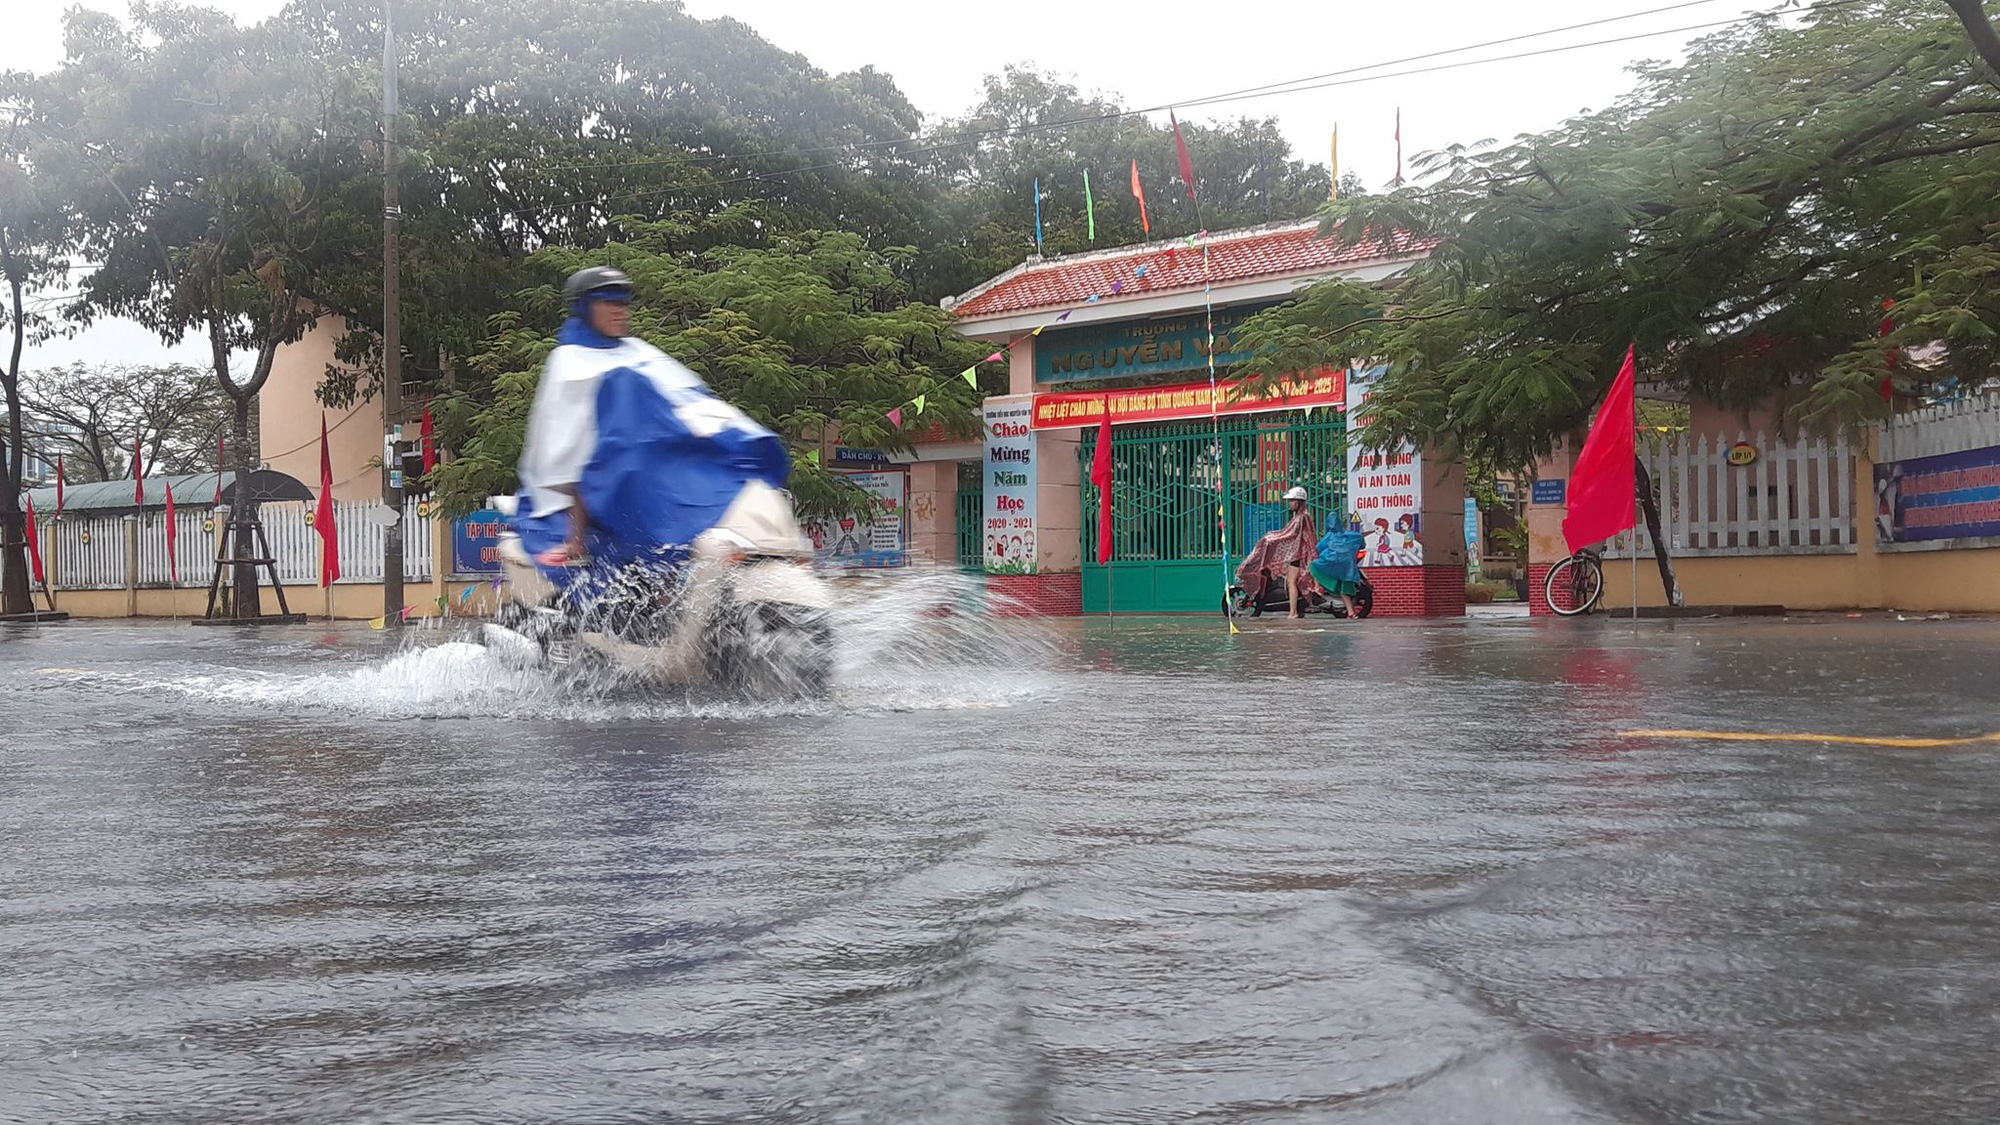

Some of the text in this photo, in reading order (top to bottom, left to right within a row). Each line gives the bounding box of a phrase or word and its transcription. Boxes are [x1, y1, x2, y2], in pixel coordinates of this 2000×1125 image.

[1051, 332, 1183, 374] NGUYỄN
[1038, 402, 1056, 421] NHIỆT
[1056, 400, 1069, 421] LIỆT
[1069, 399, 1086, 416] CHÀO
[1086, 397, 1105, 416] MỪNG
[1108, 398, 1118, 417] ẠI
[1117, 395, 1129, 416] HỘI
[1147, 391, 1157, 413] BỘ
[1195, 388, 1211, 406] NAM
[1314, 376, 1332, 394] 2025
[992, 421, 1028, 437] Chào
[991, 446, 1031, 464] Mừng
[994, 471, 1028, 486] Năm
[1358, 471, 1411, 488] VÌ AN TOÀN
[997, 495, 1025, 514] Học
[1357, 492, 1413, 509] GIAO THÔNG
[466, 520, 482, 541] TẬP
[483, 517, 500, 538] THỂ
[988, 518, 1007, 530] 2020
[1014, 517, 1033, 529] 2021
[481, 546, 502, 564] QUY
